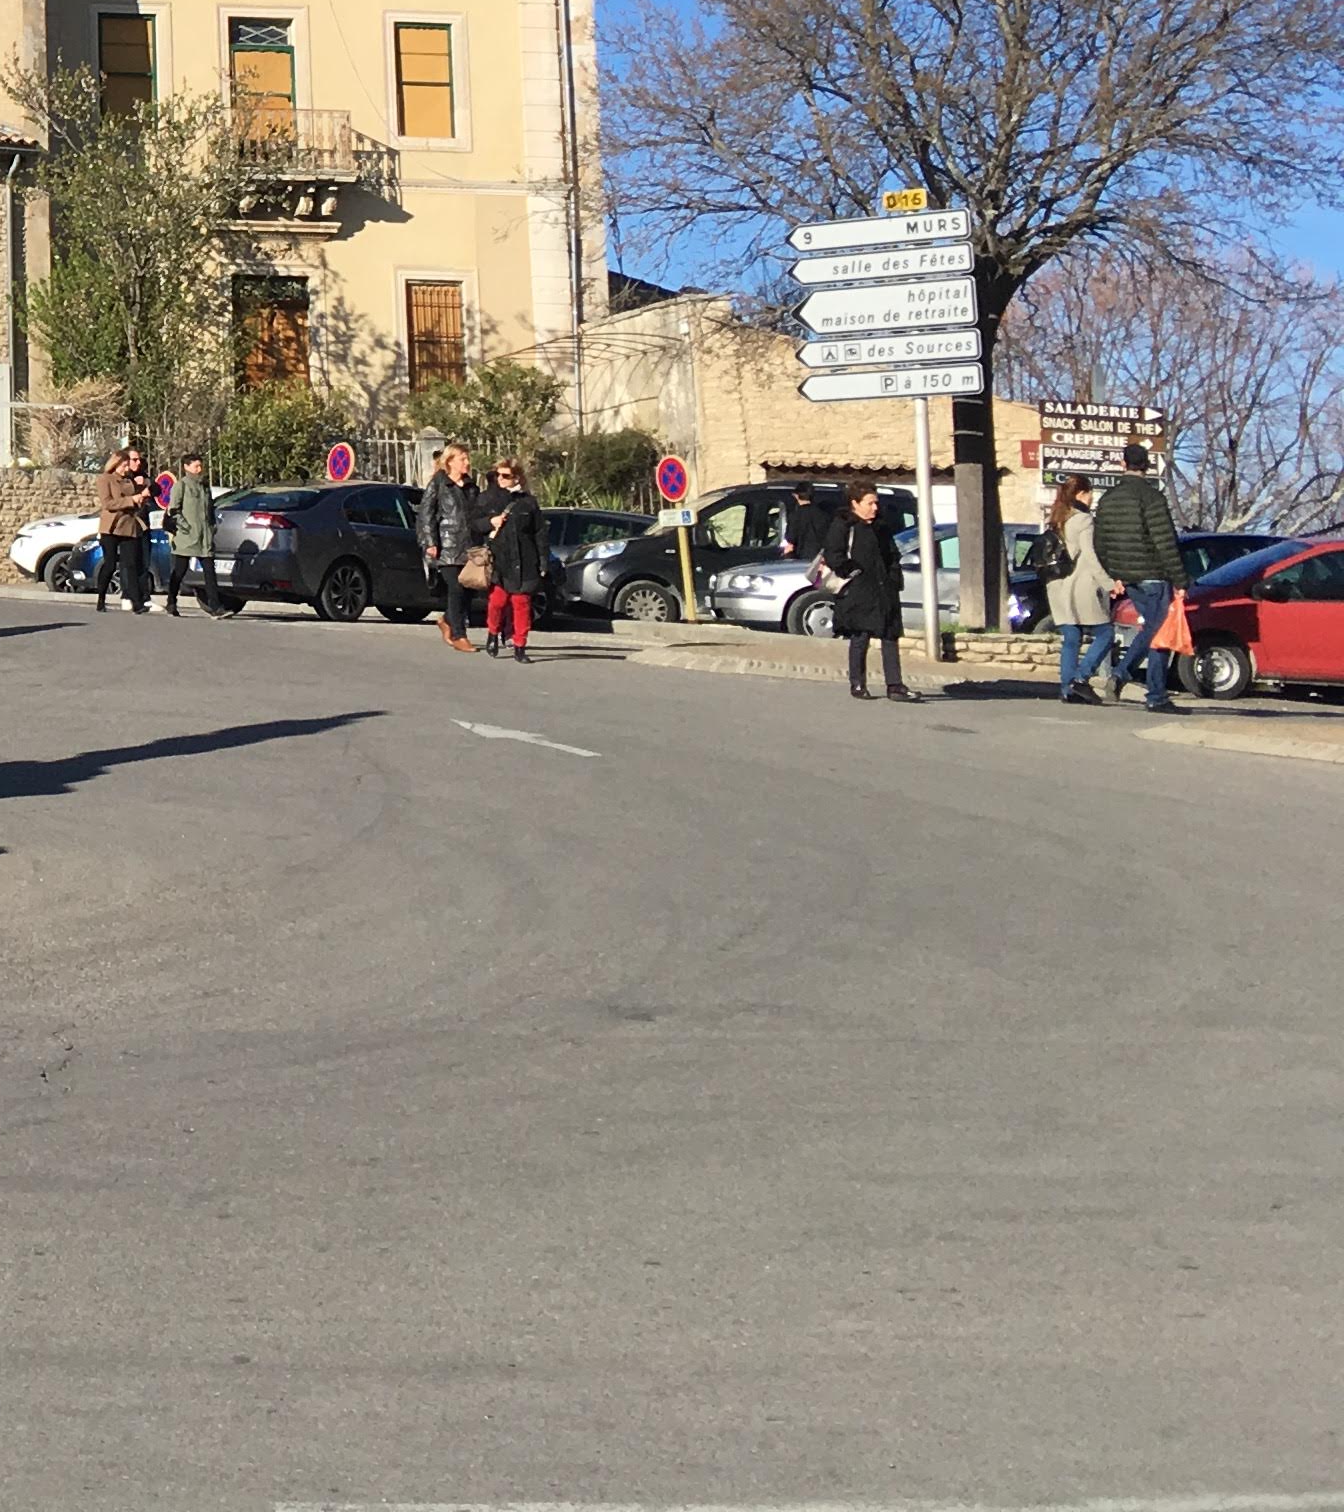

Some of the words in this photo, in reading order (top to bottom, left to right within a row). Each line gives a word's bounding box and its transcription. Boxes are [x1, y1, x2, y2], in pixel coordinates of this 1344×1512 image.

[886, 194, 897, 209] D
[803, 231, 812, 245] 9
[906, 217, 961, 235] MURS
[832, 261, 872, 275] salle
[882, 258, 909, 272] des
[919, 253, 965, 268] Fêtes
[907, 285, 968, 304] hôpital
[822, 312, 875, 328] maison
[883, 309, 900, 323] de
[908, 304, 968, 318] retraite
[868, 344, 894, 358] des
[905, 338, 972, 355] Sources
[922, 373, 952, 388] 150
[962, 375, 974, 385] m
[1044, 402, 1140, 419] SALADERIE
[1042, 416, 1076, 430] SNACK
[1080, 419, 1114, 432] SALON
[1117, 422, 1132, 434] DE
[1051, 432, 1129, 448] CREPERIE
[1044, 447, 1104, 461] BOULANGERIE
